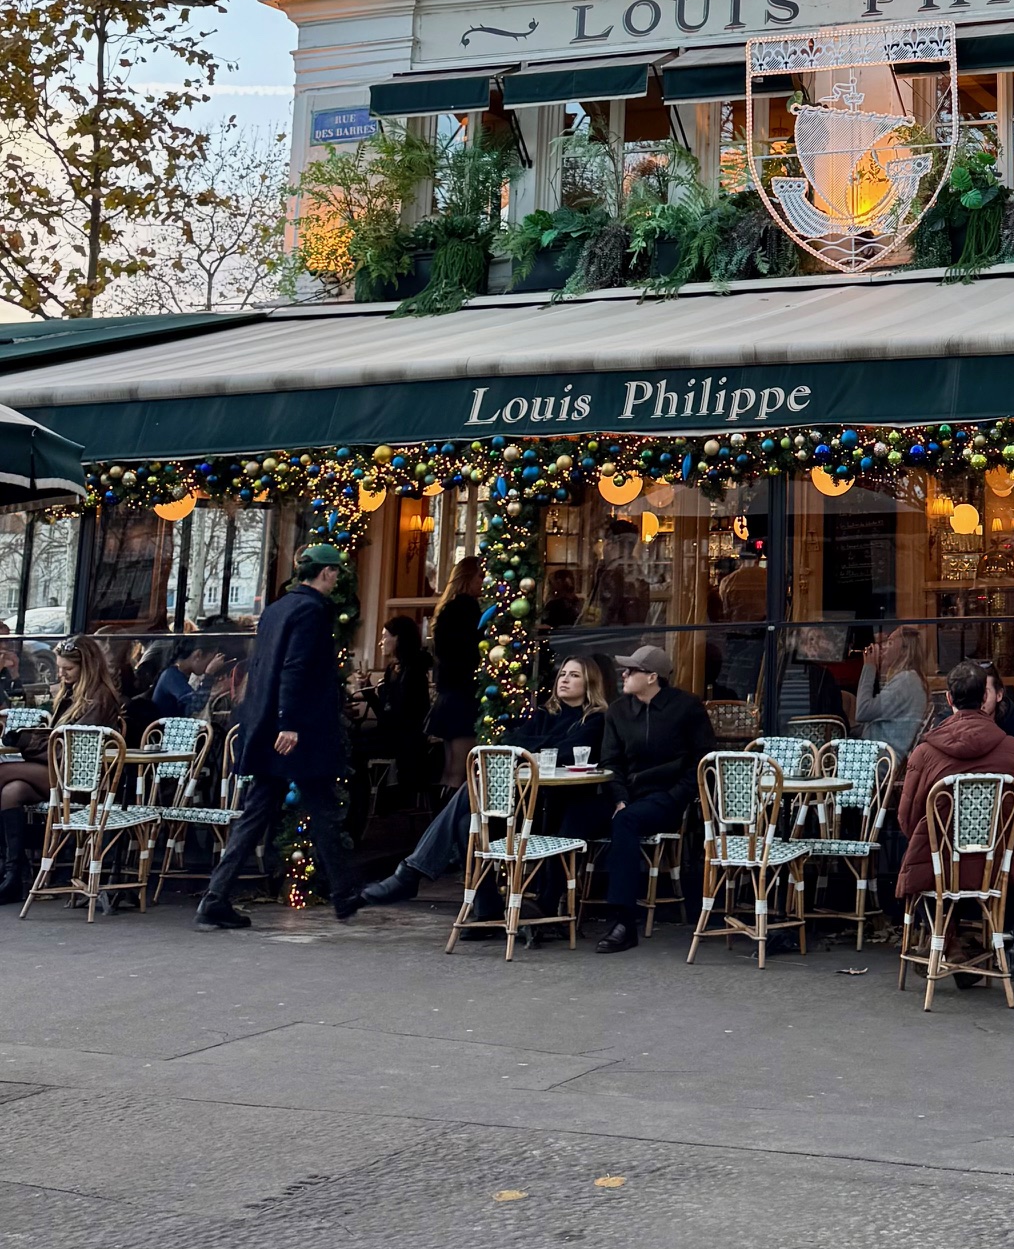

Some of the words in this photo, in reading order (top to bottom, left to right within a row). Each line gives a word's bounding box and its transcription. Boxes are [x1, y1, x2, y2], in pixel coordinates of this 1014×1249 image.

[334, 114, 357, 125] RUE
[315, 128, 334, 139] DES
[336, 124, 377, 137] BARRES
[463, 383, 593, 427] Louis
[617, 375, 812, 422] Philippe
